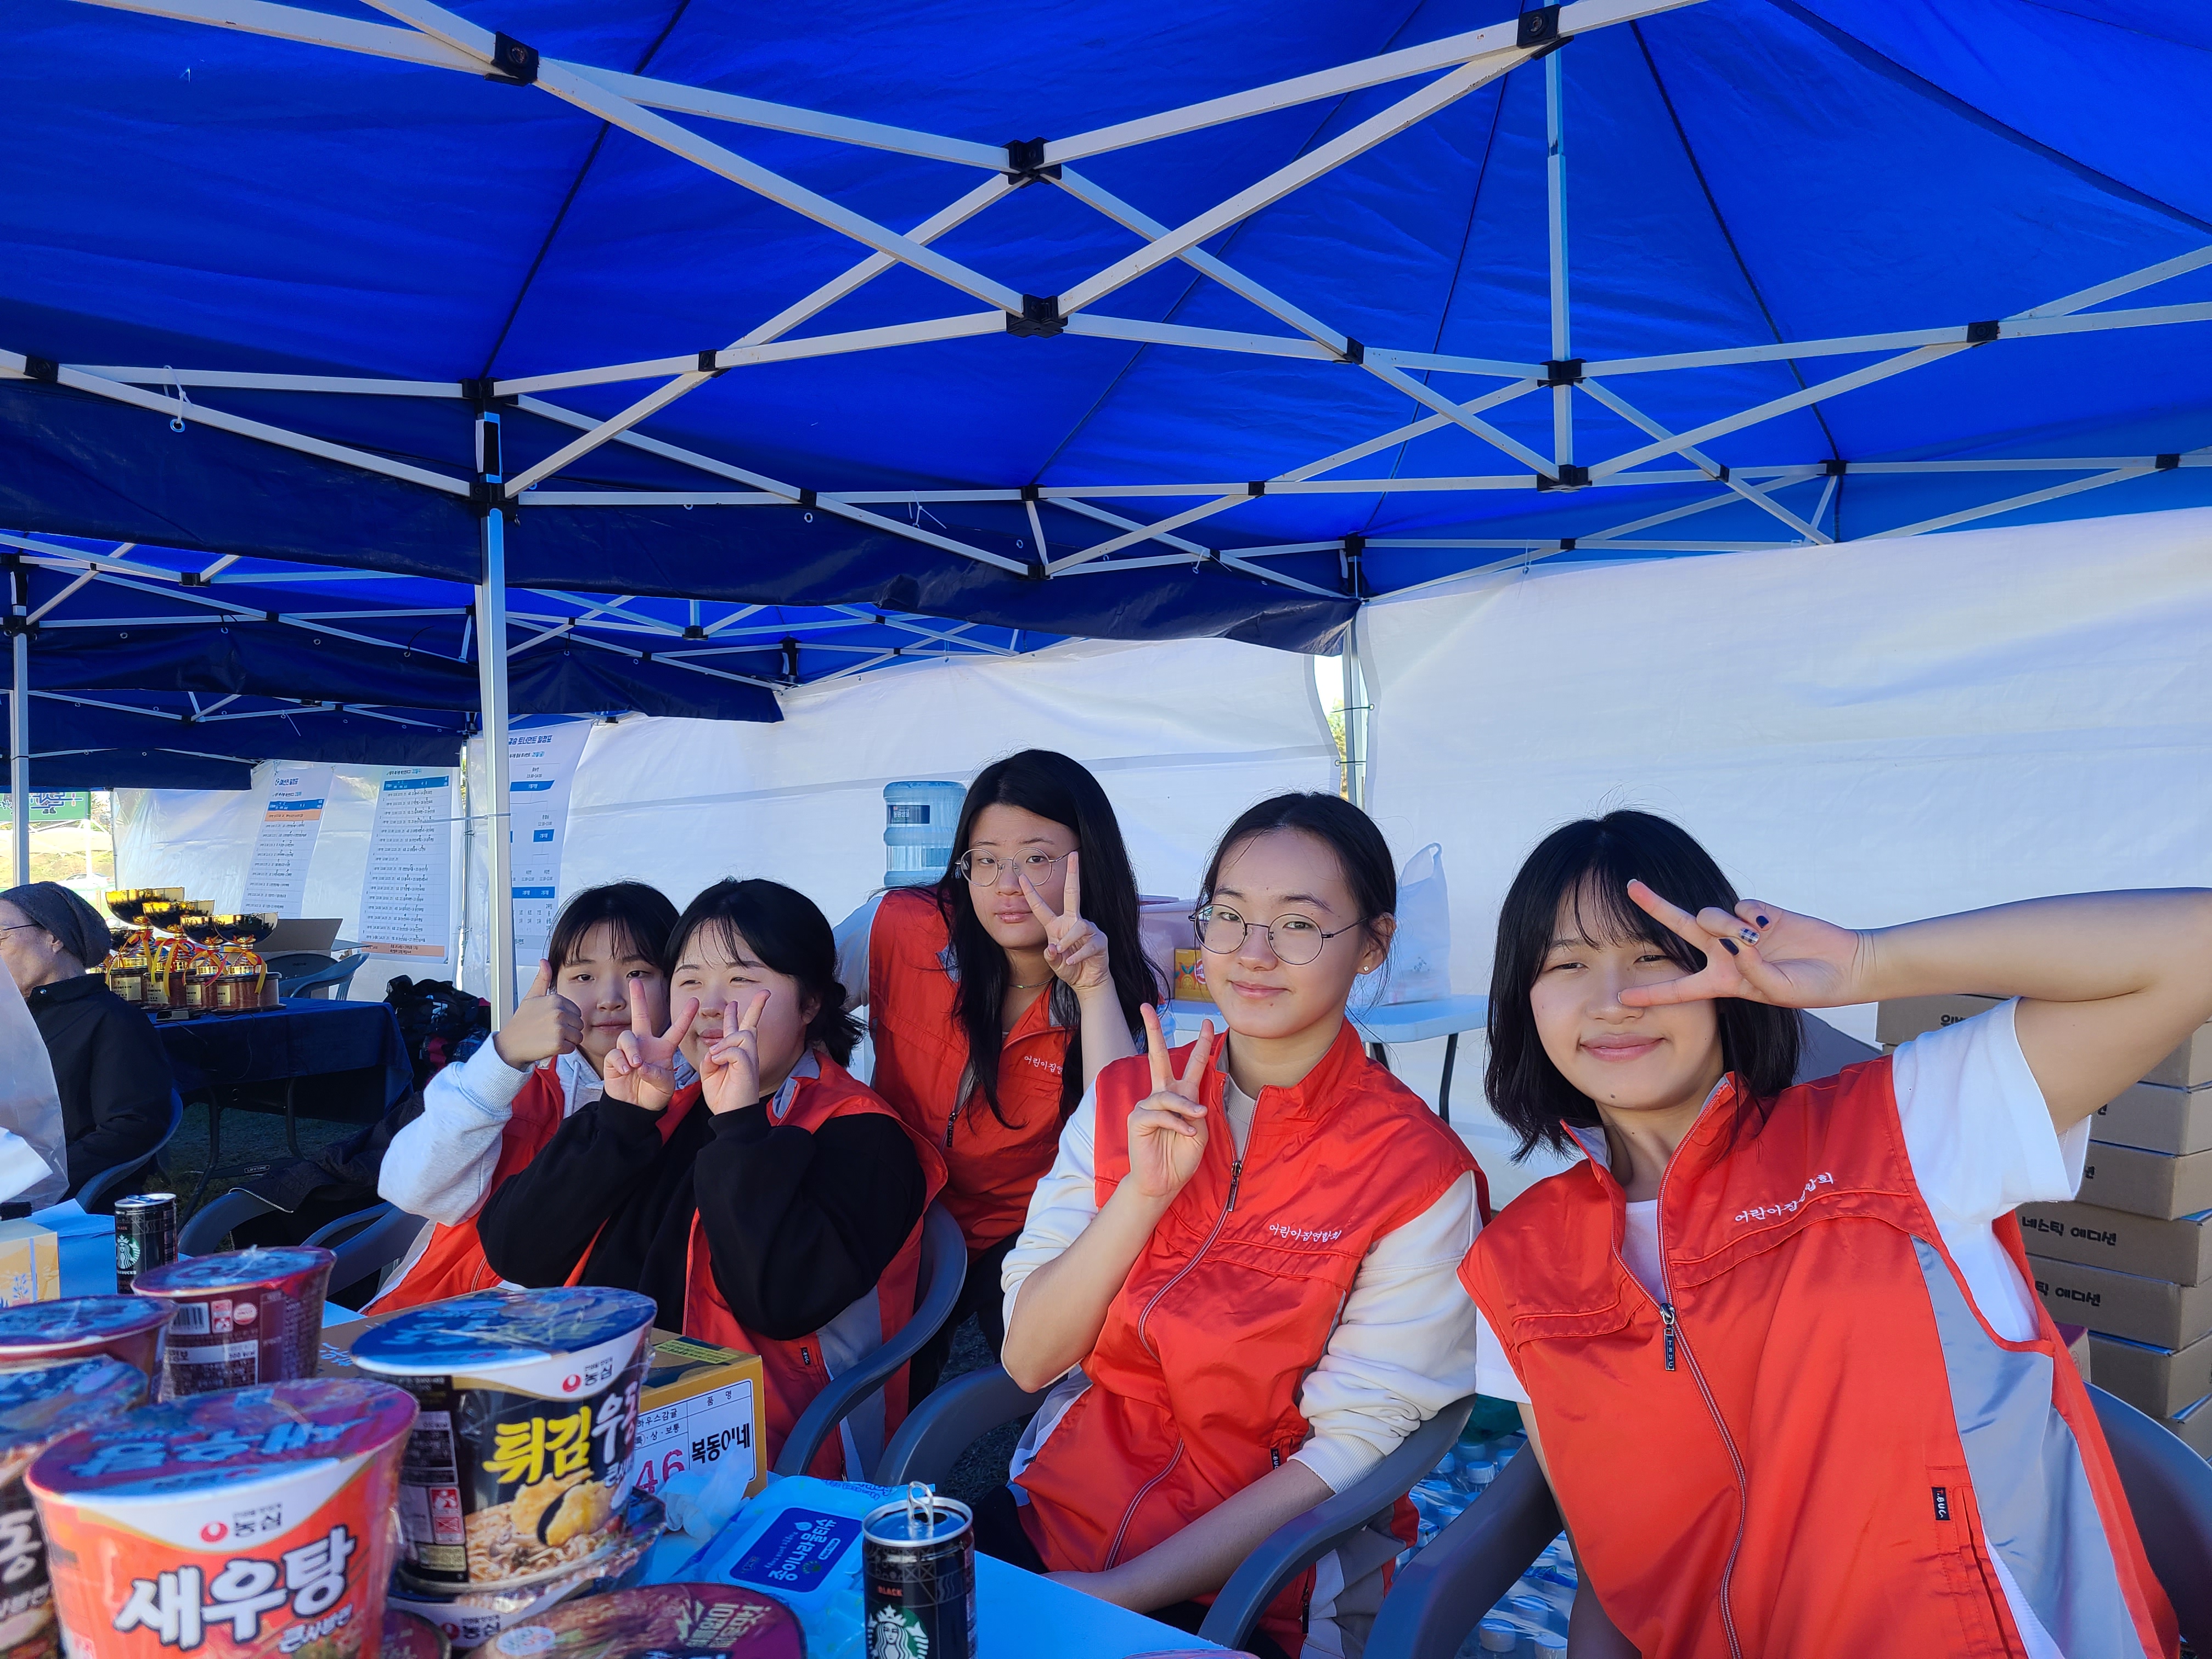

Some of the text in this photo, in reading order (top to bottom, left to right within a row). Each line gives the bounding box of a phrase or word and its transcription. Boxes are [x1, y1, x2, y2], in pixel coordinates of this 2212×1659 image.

[1269, 1223, 1342, 1243] 어린이집연합회
[2070, 1227, 2117, 1246] 에디션
[2055, 1287, 2101, 1307] 에디션
[584, 1364, 613, 1386] 농심
[707, 1390, 732, 1406] 품 명
[691, 1423, 751, 1464] 복동이네
[234, 1511, 282, 1537] 농심
[113, 1524, 357, 1651] 새우탕
[878, 1585, 902, 1597] BLACK
